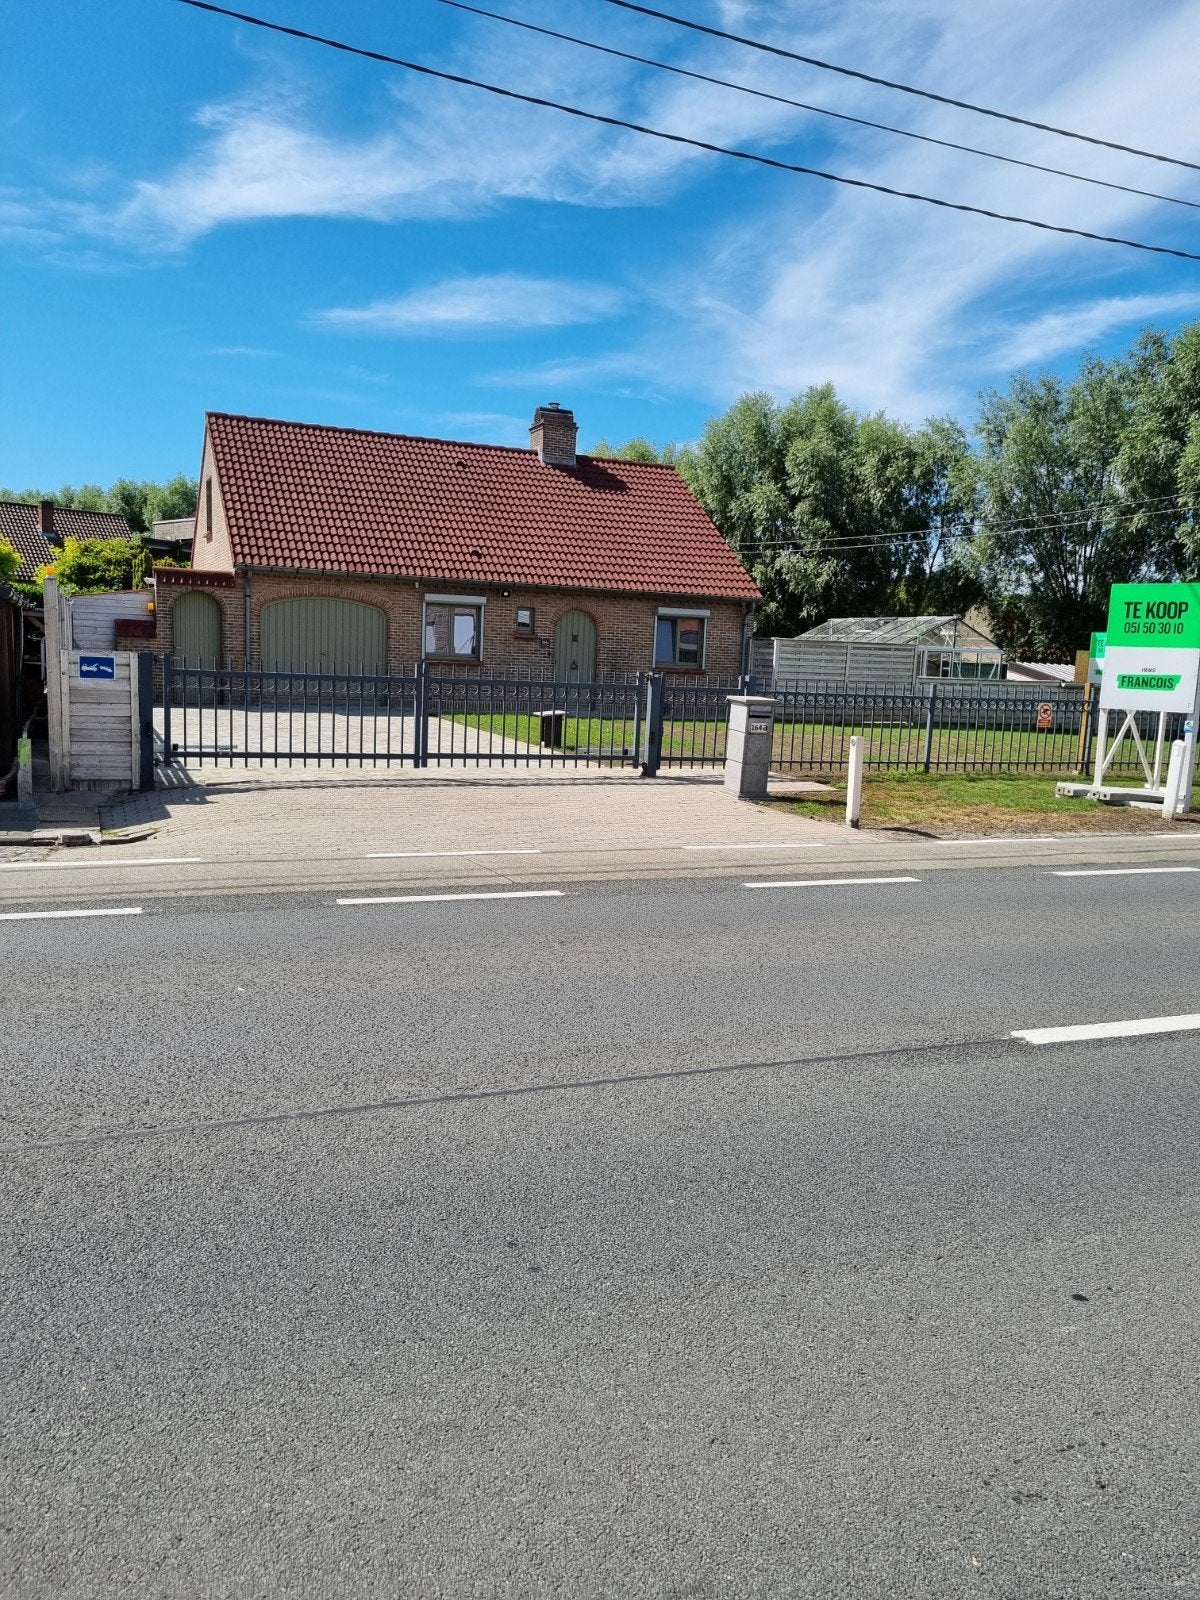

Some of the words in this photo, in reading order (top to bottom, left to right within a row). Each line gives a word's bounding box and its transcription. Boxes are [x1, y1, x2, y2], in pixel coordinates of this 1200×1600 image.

[1124, 601, 1142, 619] TE
[1145, 601, 1189, 619] KOOP
[1123, 621, 1140, 634] 051
[1142, 621, 1156, 634] 50
[1158, 621, 1171, 634] 30
[1173, 622, 1184, 635] 10
[1120, 675, 1175, 689] FRANCOIS
